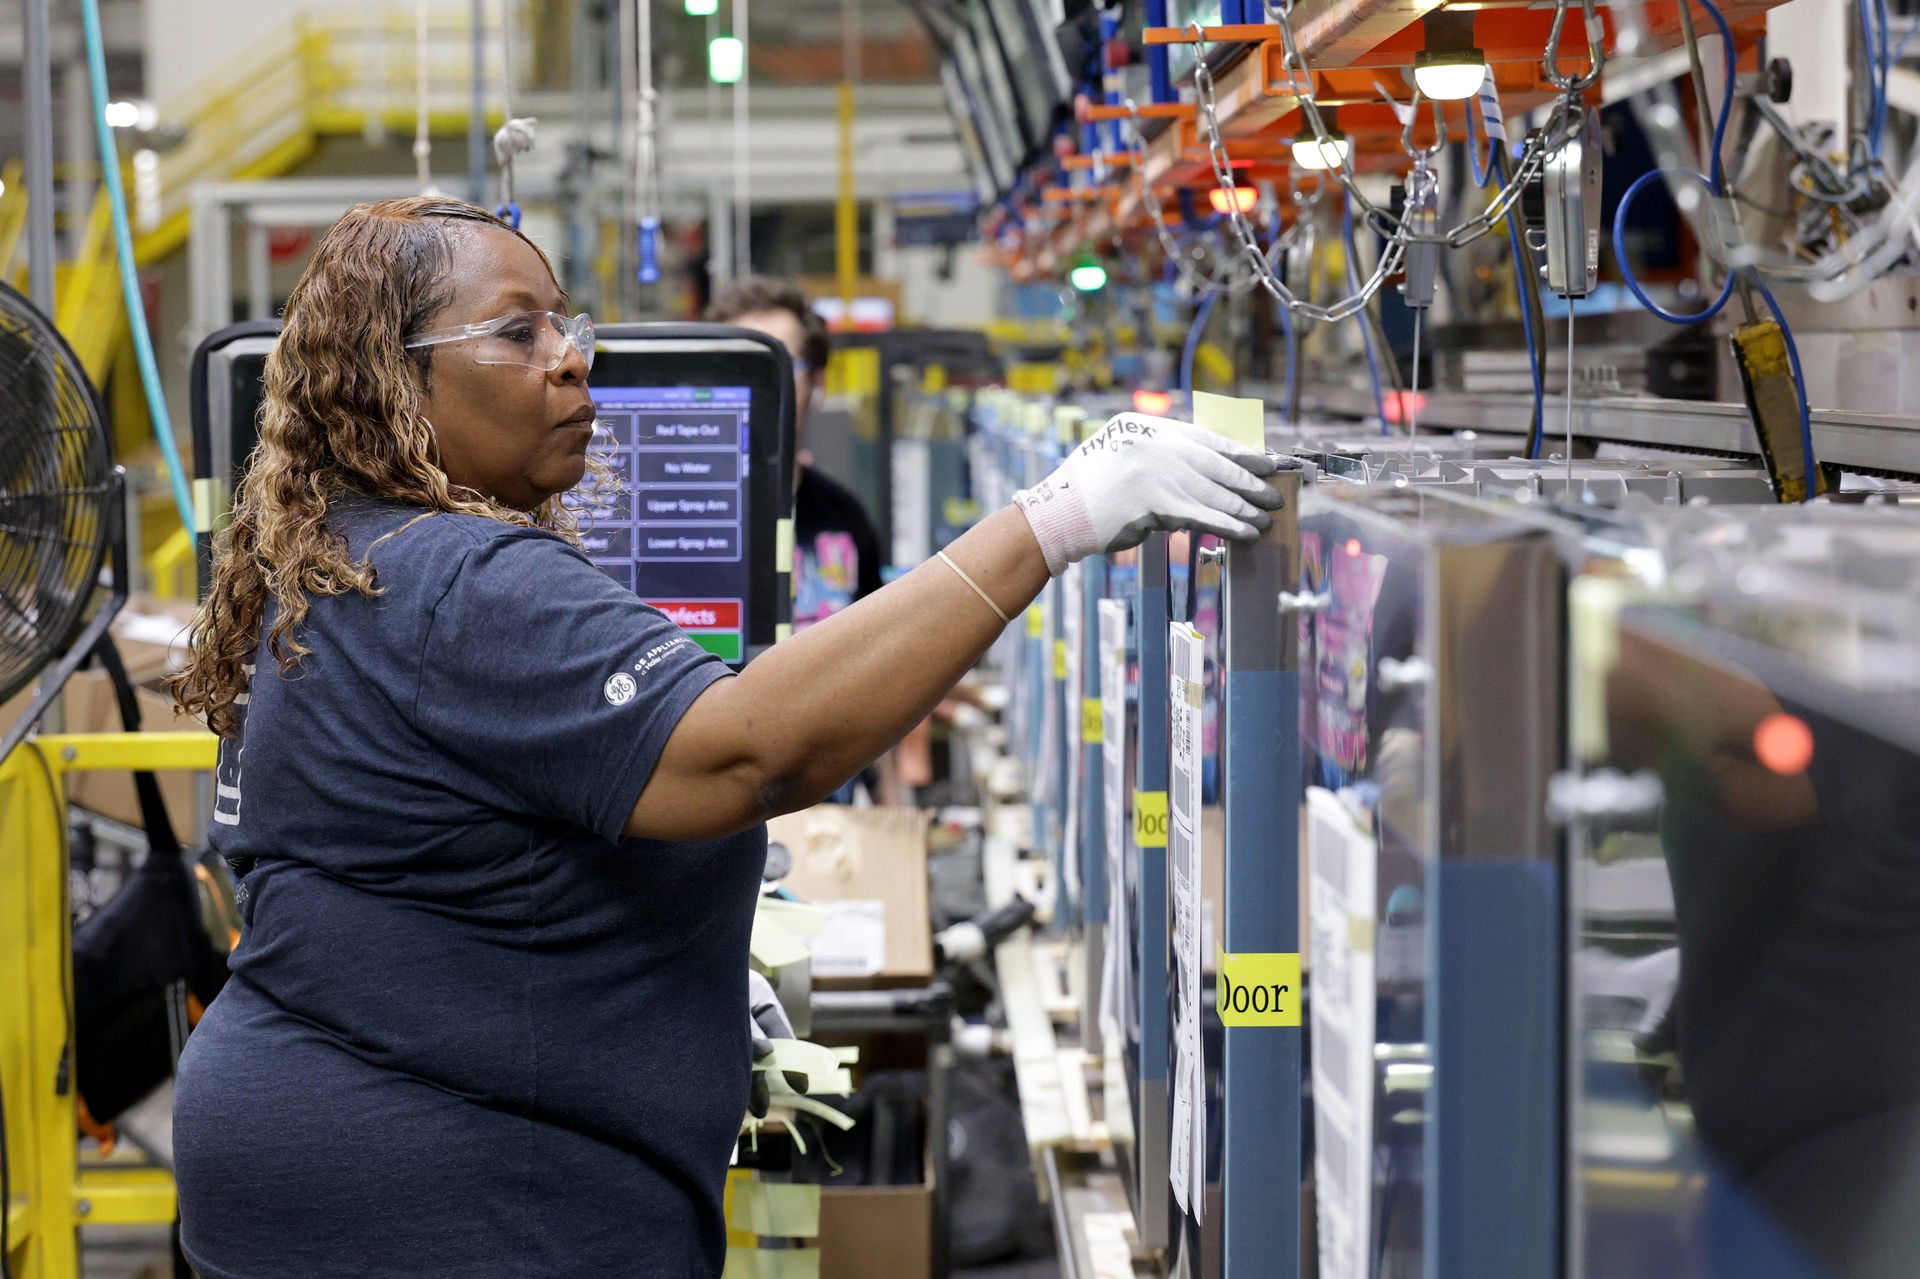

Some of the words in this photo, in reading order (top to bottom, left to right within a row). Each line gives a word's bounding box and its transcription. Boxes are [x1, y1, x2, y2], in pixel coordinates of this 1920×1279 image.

[655, 424, 676, 437] Red
[677, 425, 699, 438] Tape
[700, 424, 720, 437] Out
[1081, 418, 1154, 457] HyFlex
[664, 462, 681, 474] No
[681, 462, 712, 474] Water
[647, 500, 678, 513] Upper
[678, 500, 706, 513] Spray
[706, 500, 729, 511] Arm
[647, 537, 678, 549] Lower
[678, 537, 706, 551] Spray
[706, 537, 729, 549] Arm
[634, 657, 647, 671] GE
